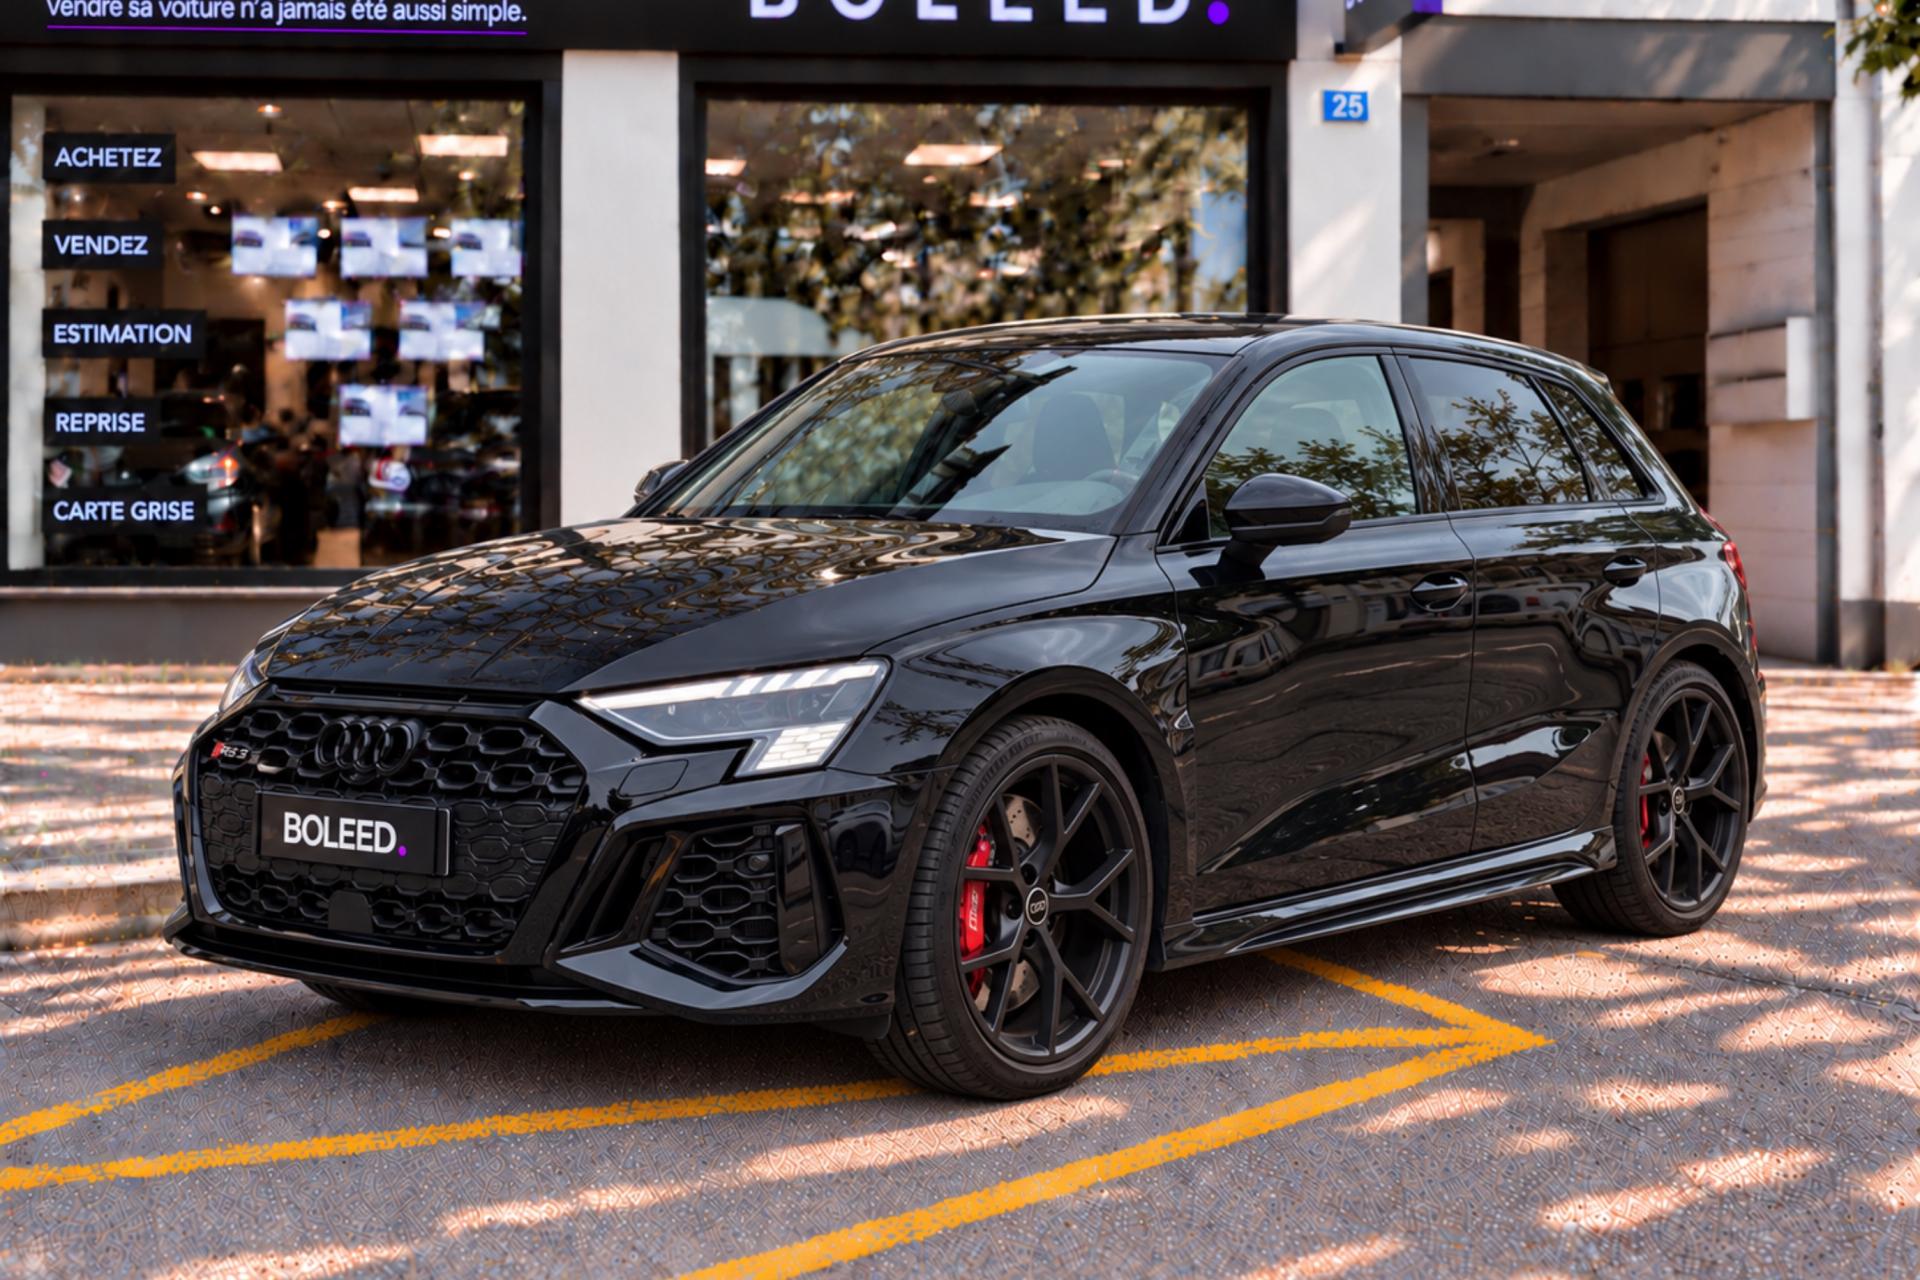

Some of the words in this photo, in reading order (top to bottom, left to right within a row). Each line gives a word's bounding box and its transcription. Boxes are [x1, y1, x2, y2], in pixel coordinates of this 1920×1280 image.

[46, 0, 124, 17] Vendre
[128, 0, 153, 18] sa
[158, 0, 236, 19] voiture
[275, 0, 347, 26] jamais
[351, 0, 388, 21] été
[392, 0, 447, 22] aussi
[450, 0, 528, 27] simple.
[1331, 93, 1364, 118] 25
[54, 146, 162, 168] ACHETEZ
[54, 234, 149, 256] VENDEZ
[52, 323, 193, 344] ESTIMATION
[55, 412, 146, 433] REPRISE
[53, 500, 126, 521] CARTE
[130, 500, 195, 521] GRISE
[283, 811, 407, 857] BOLEED.
